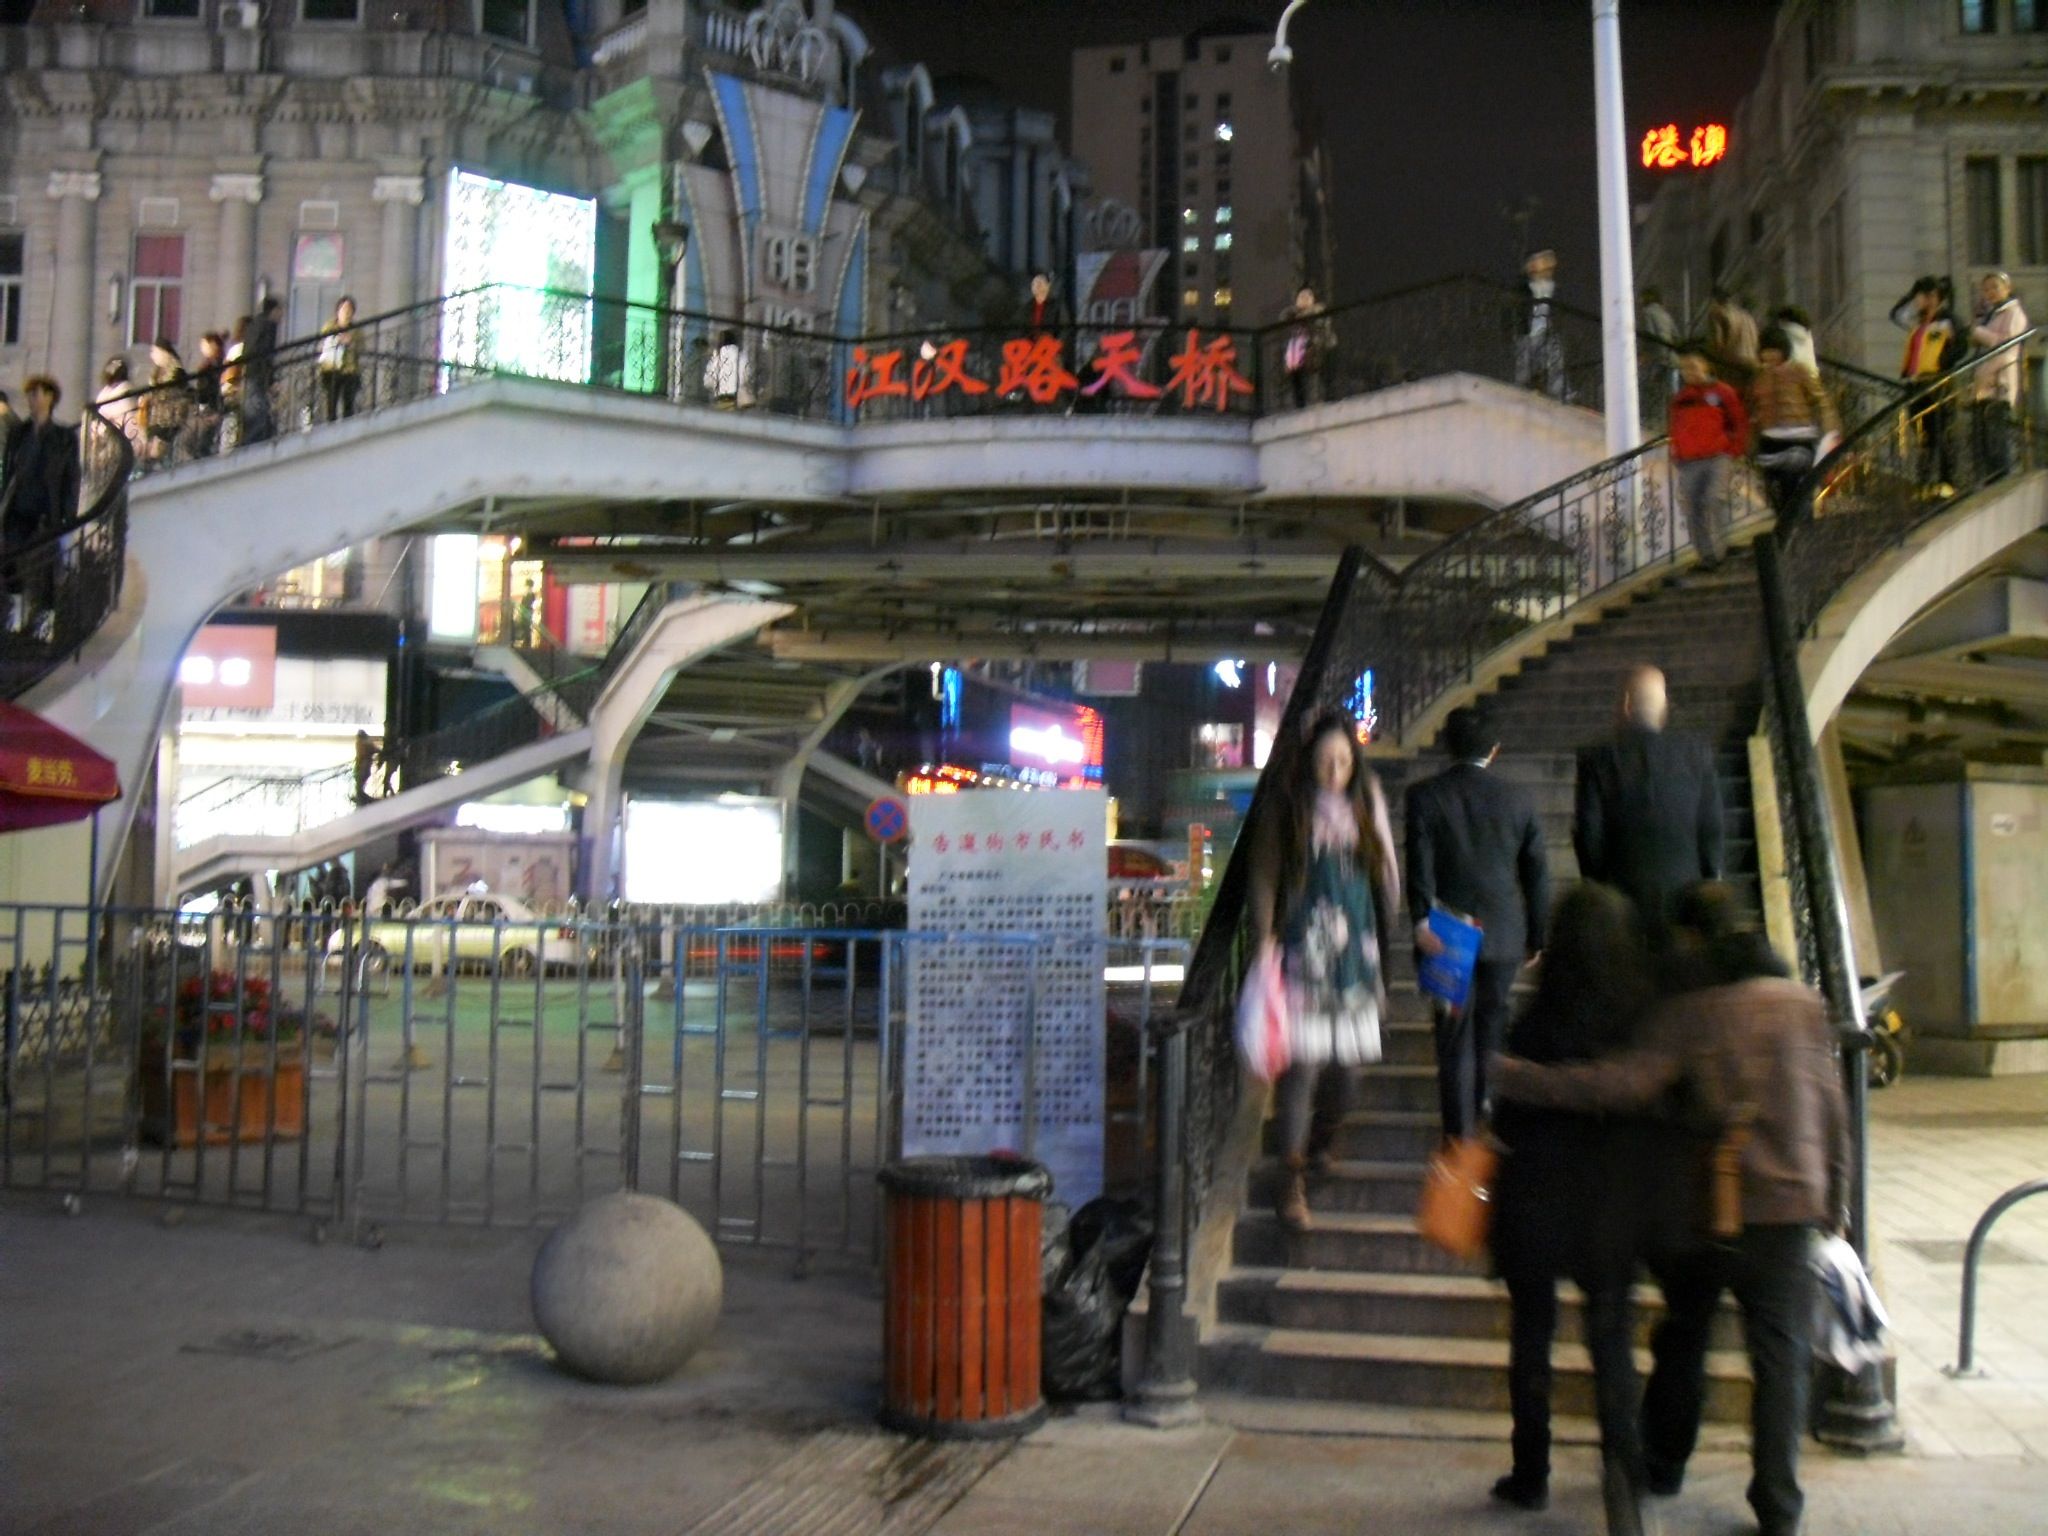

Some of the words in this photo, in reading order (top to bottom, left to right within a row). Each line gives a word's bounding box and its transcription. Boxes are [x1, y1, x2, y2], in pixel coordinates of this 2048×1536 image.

[847, 329, 1254, 412] 江汉路天桥
[28, 757, 74, 785] 麦当劳
